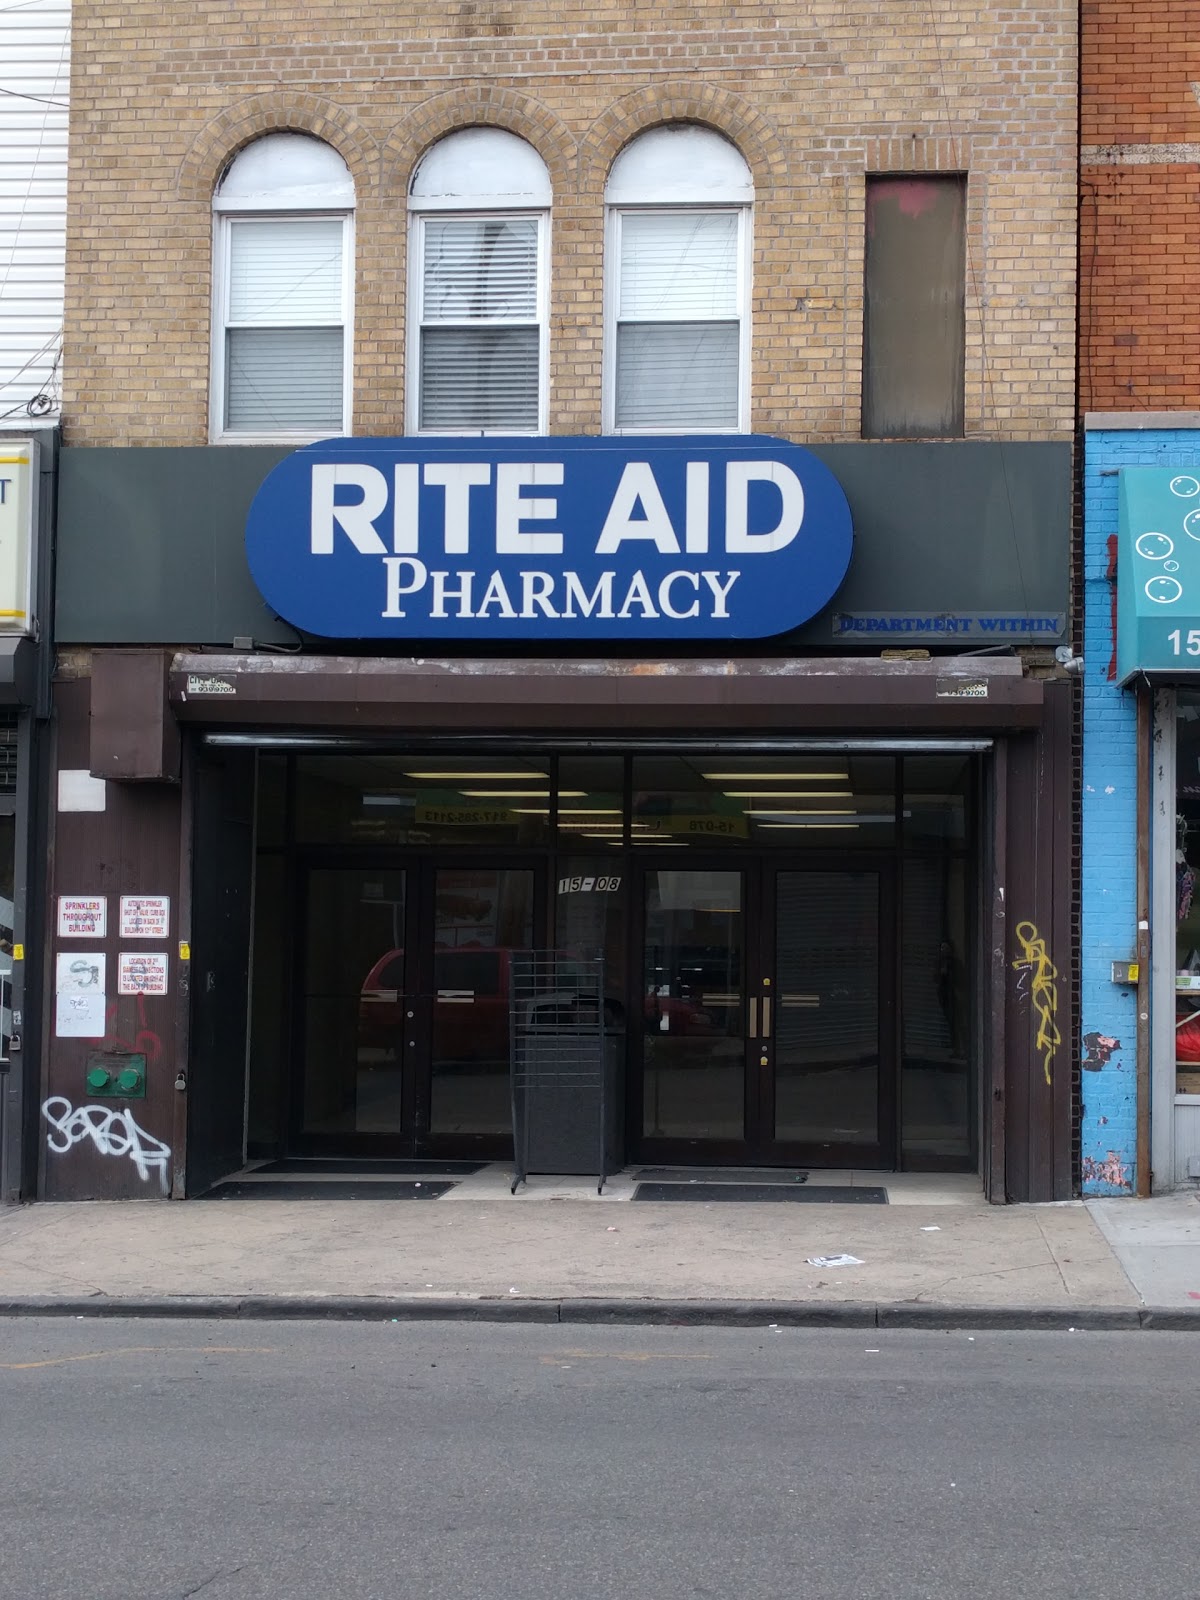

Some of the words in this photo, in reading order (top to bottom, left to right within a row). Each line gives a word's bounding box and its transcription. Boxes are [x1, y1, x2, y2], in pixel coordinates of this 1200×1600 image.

[311, 463, 564, 555] RITE
[595, 461, 805, 555] AID
[382, 556, 741, 619] PHARMACY
[840, 617, 973, 632] DEPARTMENT
[978, 617, 1058, 632] WITHIN
[561, 877, 620, 892] 15-08
[65, 901, 100, 910] SPRINKLERS
[62, 913, 102, 922] THROUGHOUT
